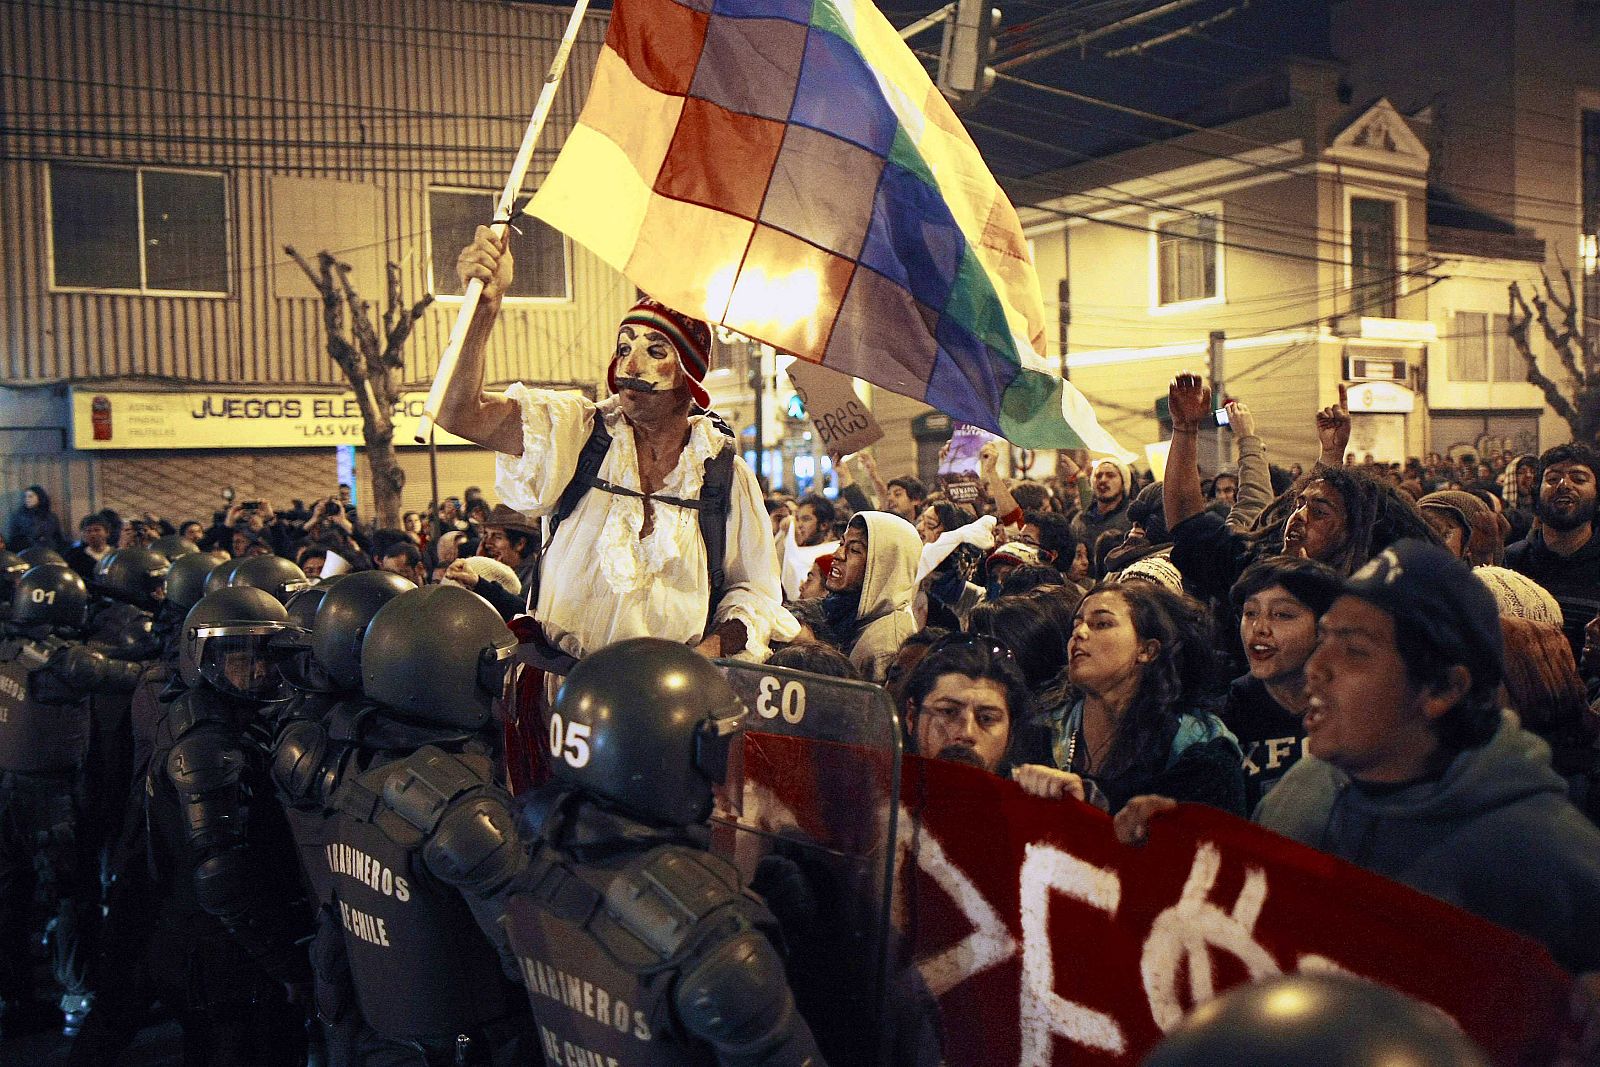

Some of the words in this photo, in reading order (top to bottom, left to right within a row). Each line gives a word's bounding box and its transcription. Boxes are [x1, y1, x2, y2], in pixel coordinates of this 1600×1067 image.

[191, 396, 302, 419] JUEGOS
[32, 588, 56, 605] 01
[550, 713, 592, 769] 05
[351, 906, 390, 947] CHILE
